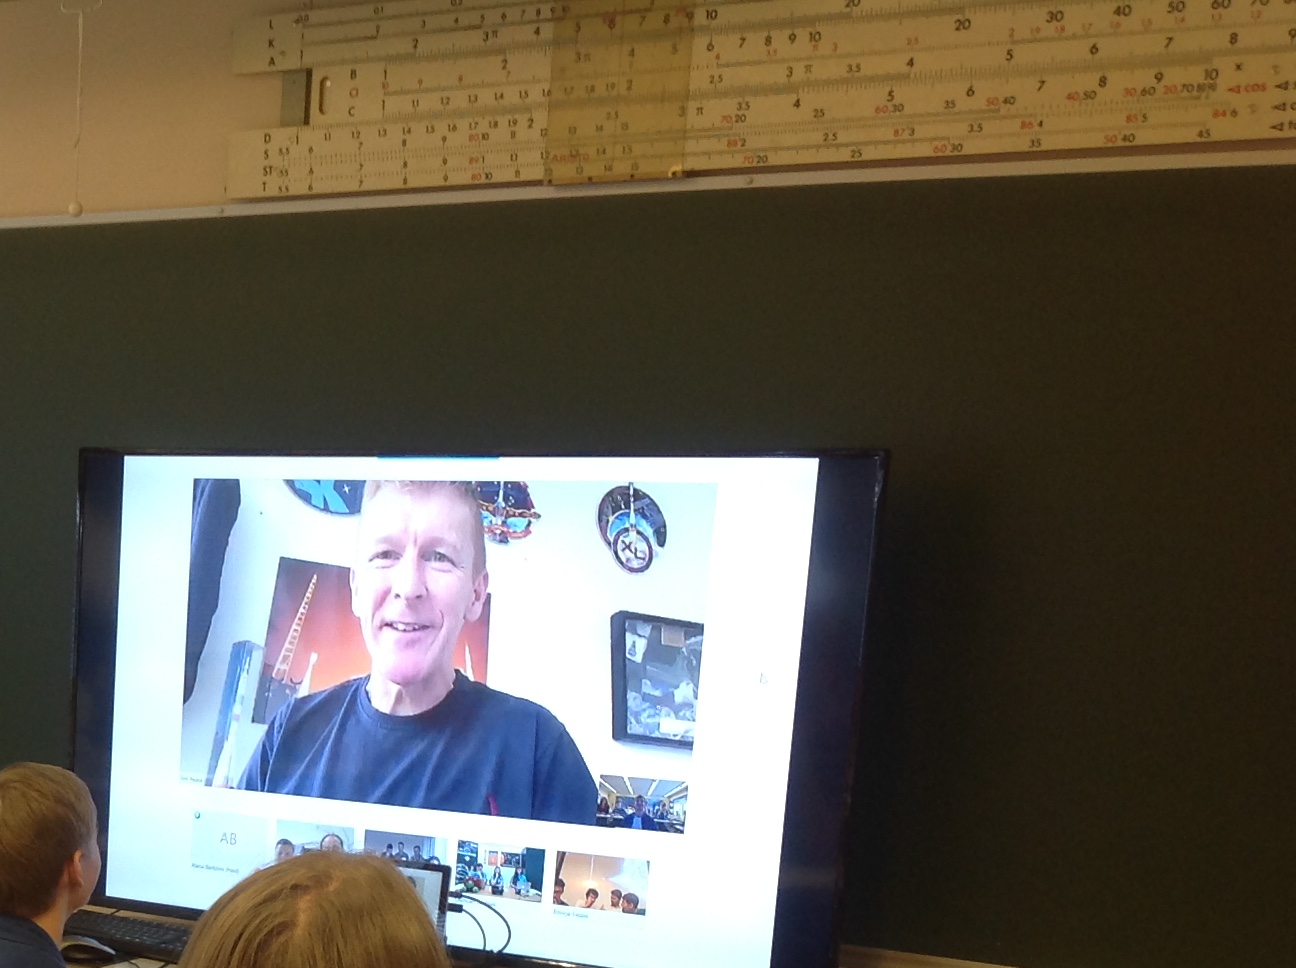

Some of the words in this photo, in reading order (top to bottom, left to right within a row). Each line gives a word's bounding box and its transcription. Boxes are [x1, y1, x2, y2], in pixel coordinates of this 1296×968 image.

[268, 56, 275, 67] A
[412, 37, 419, 49] 2
[482, 31, 489, 42] 3
[533, 26, 540, 37] 4
[706, 9, 718, 20] 10
[268, 39, 275, 48] K
[350, 68, 358, 80] B
[501, 58, 508, 70] 2
[739, 36, 747, 49] 7
[764, 34, 773, 47] 8
[788, 32, 797, 45] 9
[809, 31, 822, 43] 10
[954, 18, 971, 31] 20
[1046, 10, 1065, 23] 30
[1113, 4, 1132, 17] 40
[1166, 1, 1186, 14] 50
[1211, 0, 1230, 10] 60
[348, 106, 355, 117] C
[786, 66, 793, 78] 3
[907, 57, 914, 68] 4
[1005, 48, 1014, 62] 5
[1090, 43, 1099, 56] 6
[1164, 36, 1174, 49] 7
[1229, 32, 1238, 45] 8
[734, 113, 747, 123] 20
[812, 108, 825, 118] 25
[874, 104, 889, 115] 60
[891, 103, 904, 113] 30
[944, 99, 956, 110] 35
[1002, 95, 1017, 105] 40
[1083, 90, 1097, 100] 50
[1122, 87, 1137, 98] 30
[1140, 86, 1156, 97] 60
[1162, 84, 1178, 95] 20
[1179, 83, 1196, 94] 70
[264, 133, 271, 144] D
[527, 118, 534, 129] 2
[793, 98, 801, 109] 4
[887, 89, 895, 102] 5
[966, 86, 975, 97] 6
[1037, 79, 1046, 92] 7
[1098, 75, 1107, 88] 8
[1154, 72, 1164, 84] 9
[1205, 68, 1219, 81] 10
[263, 165, 272, 177] ST
[908, 127, 915, 137] 3
[1141, 112, 1148, 123] 5
[756, 154, 768, 164] 20
[850, 148, 862, 159] 25
[933, 143, 947, 154] 60
[949, 143, 963, 153] 30
[1029, 138, 1042, 148] 35
[1104, 134, 1118, 144] 50
[1121, 133, 1136, 143] 40
[1196, 128, 1211, 139] 45
[219, 831, 237, 846] AB
